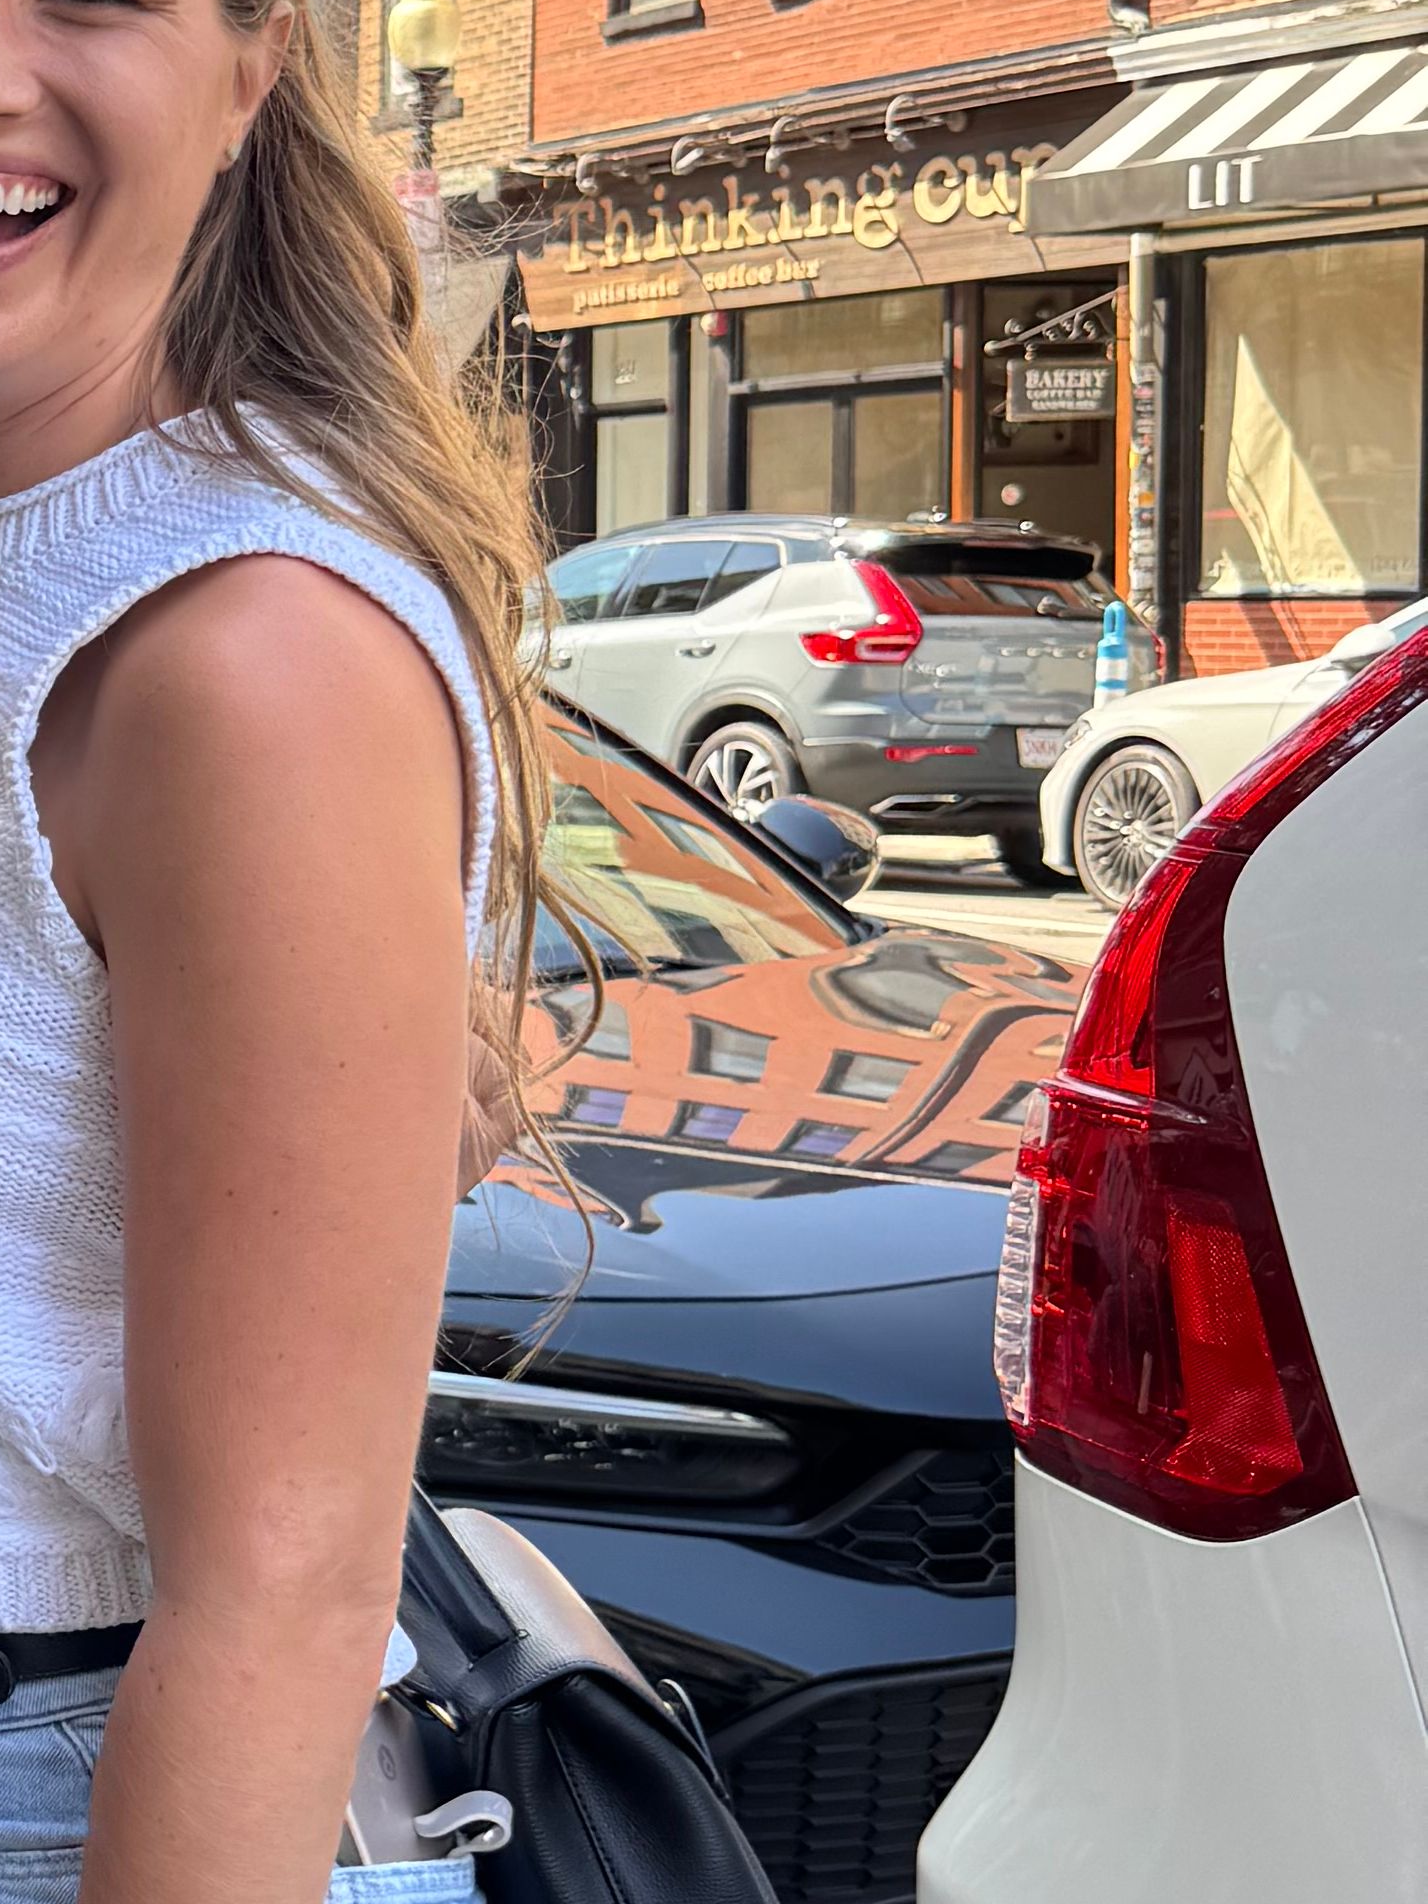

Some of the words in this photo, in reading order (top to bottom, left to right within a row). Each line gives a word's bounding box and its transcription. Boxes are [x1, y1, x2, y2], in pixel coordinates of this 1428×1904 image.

[1187, 154, 1263, 211] LIT
[554, 160, 903, 274] Thinking
[702, 263, 775, 292] coffee
[775, 257, 822, 283] bar
[1025, 368, 1109, 389] BAKERY
